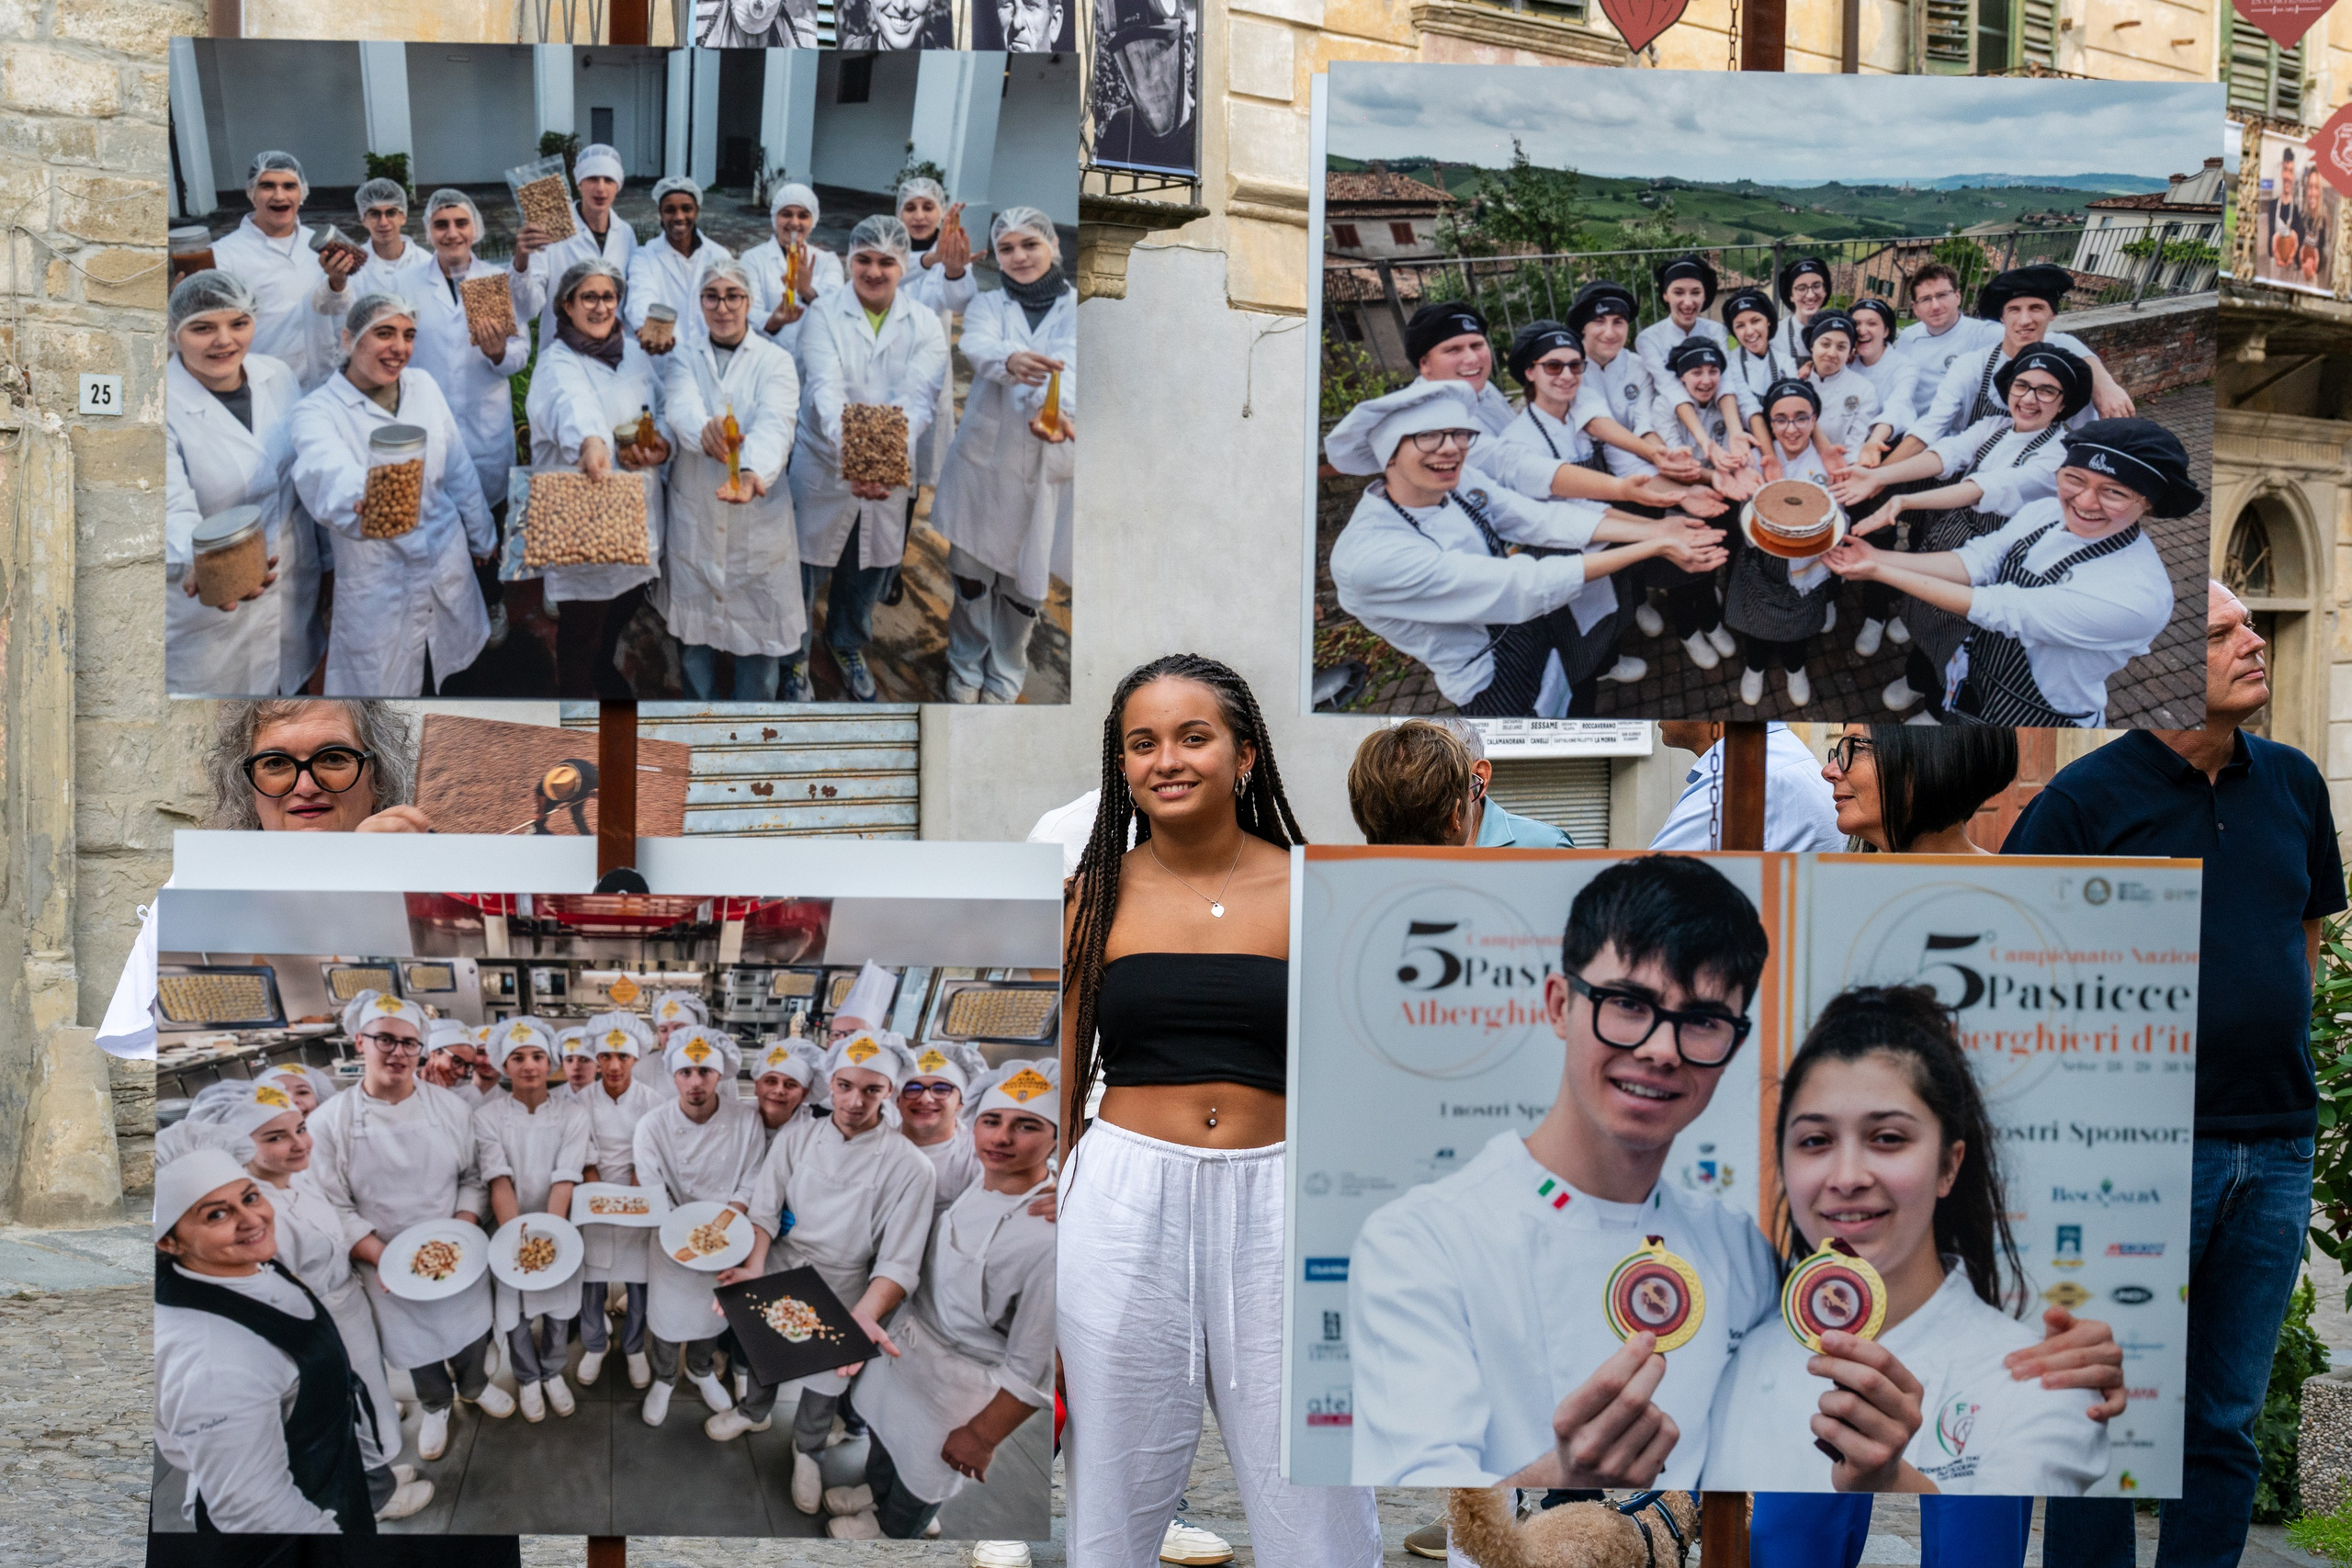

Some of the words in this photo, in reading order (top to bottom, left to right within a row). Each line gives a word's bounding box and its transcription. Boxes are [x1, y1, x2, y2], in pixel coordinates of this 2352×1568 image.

[91, 383, 111, 405] 25
[1530, 721, 1558, 729] SESSAME
[1987, 975, 2192, 1012] Pasticce
[1453, 1102, 1510, 1118] nostri
[1997, 1119, 2059, 1143] ostri
[2069, 1121, 2190, 1148] Sponsor:
[1955, 1402, 1968, 1416] F
